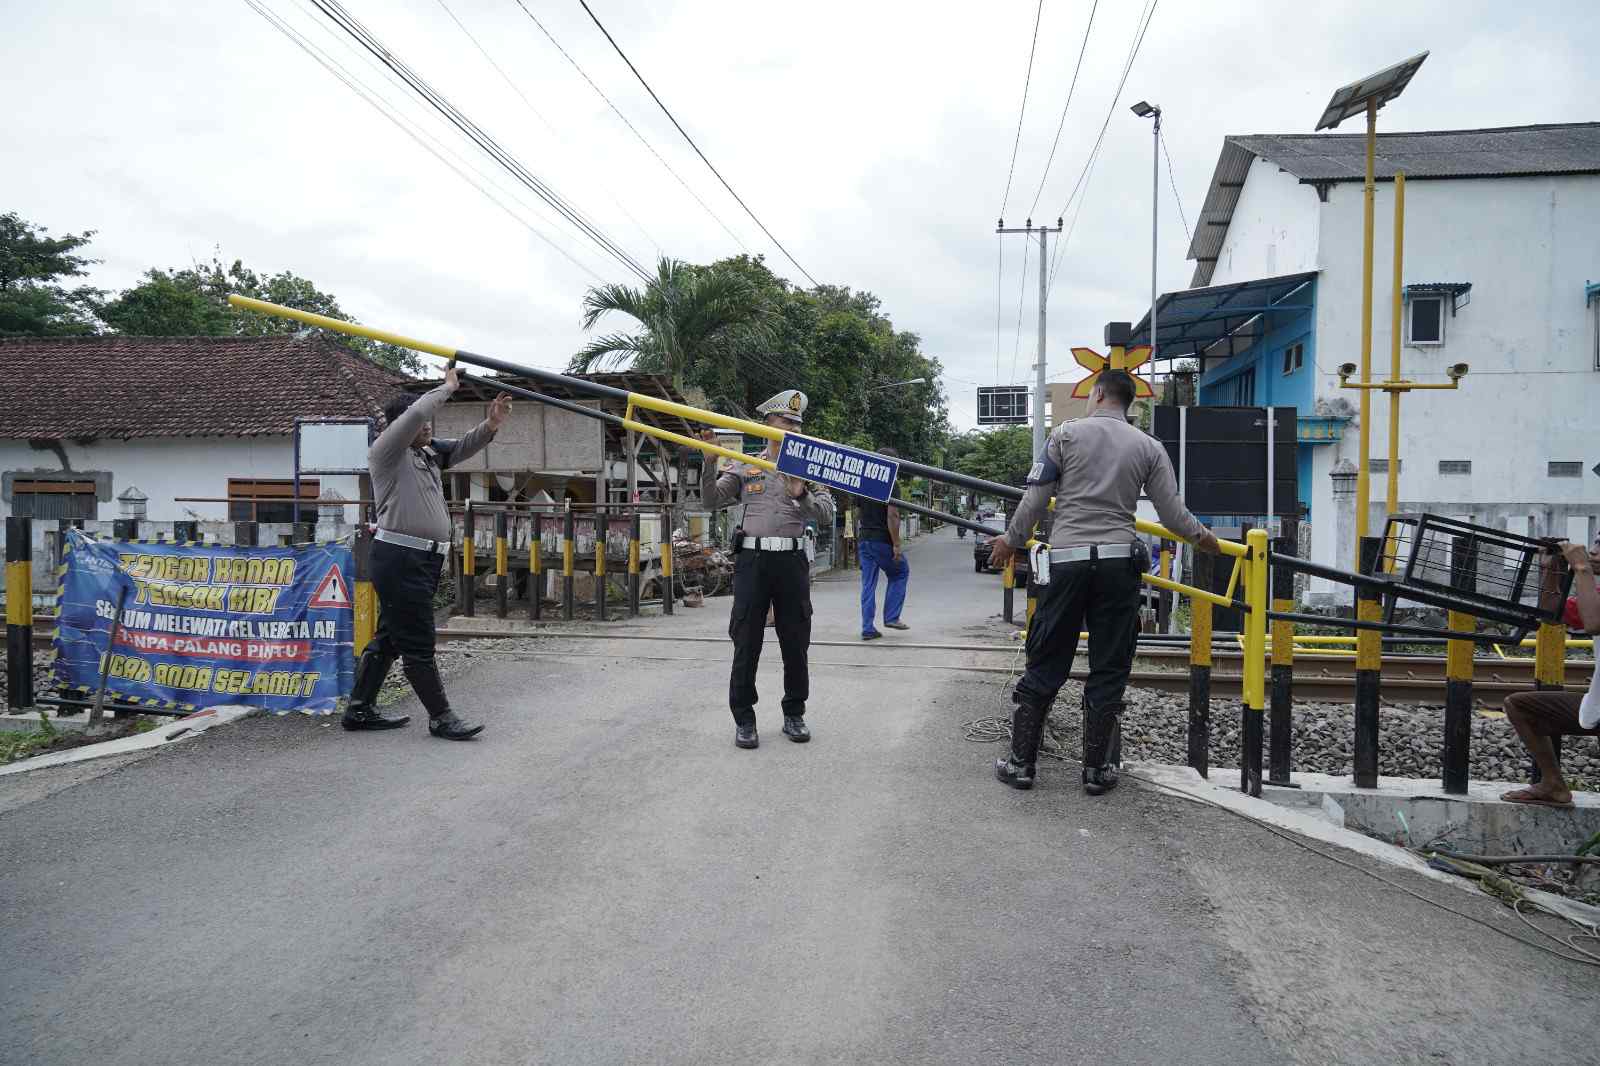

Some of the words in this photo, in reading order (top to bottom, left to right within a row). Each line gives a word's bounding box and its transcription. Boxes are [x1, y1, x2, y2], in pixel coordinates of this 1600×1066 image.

[786, 440, 805, 460] SAT.
[806, 445, 843, 470] LANTAS
[864, 461, 891, 483] KOTA
[119, 552, 210, 584] TENGOK
[212, 557, 296, 587] KANAN
[135, 580, 227, 612] TENGOK
[152, 613, 226, 637] MELEWATI
[228, 620, 256, 639] REL
[258, 620, 310, 639] KERETA
[174, 638, 242, 658] PALANG
[248, 641, 298, 659] PINTU
[154, 662, 211, 692] ANDA
[213, 668, 321, 697] SELAMAT
